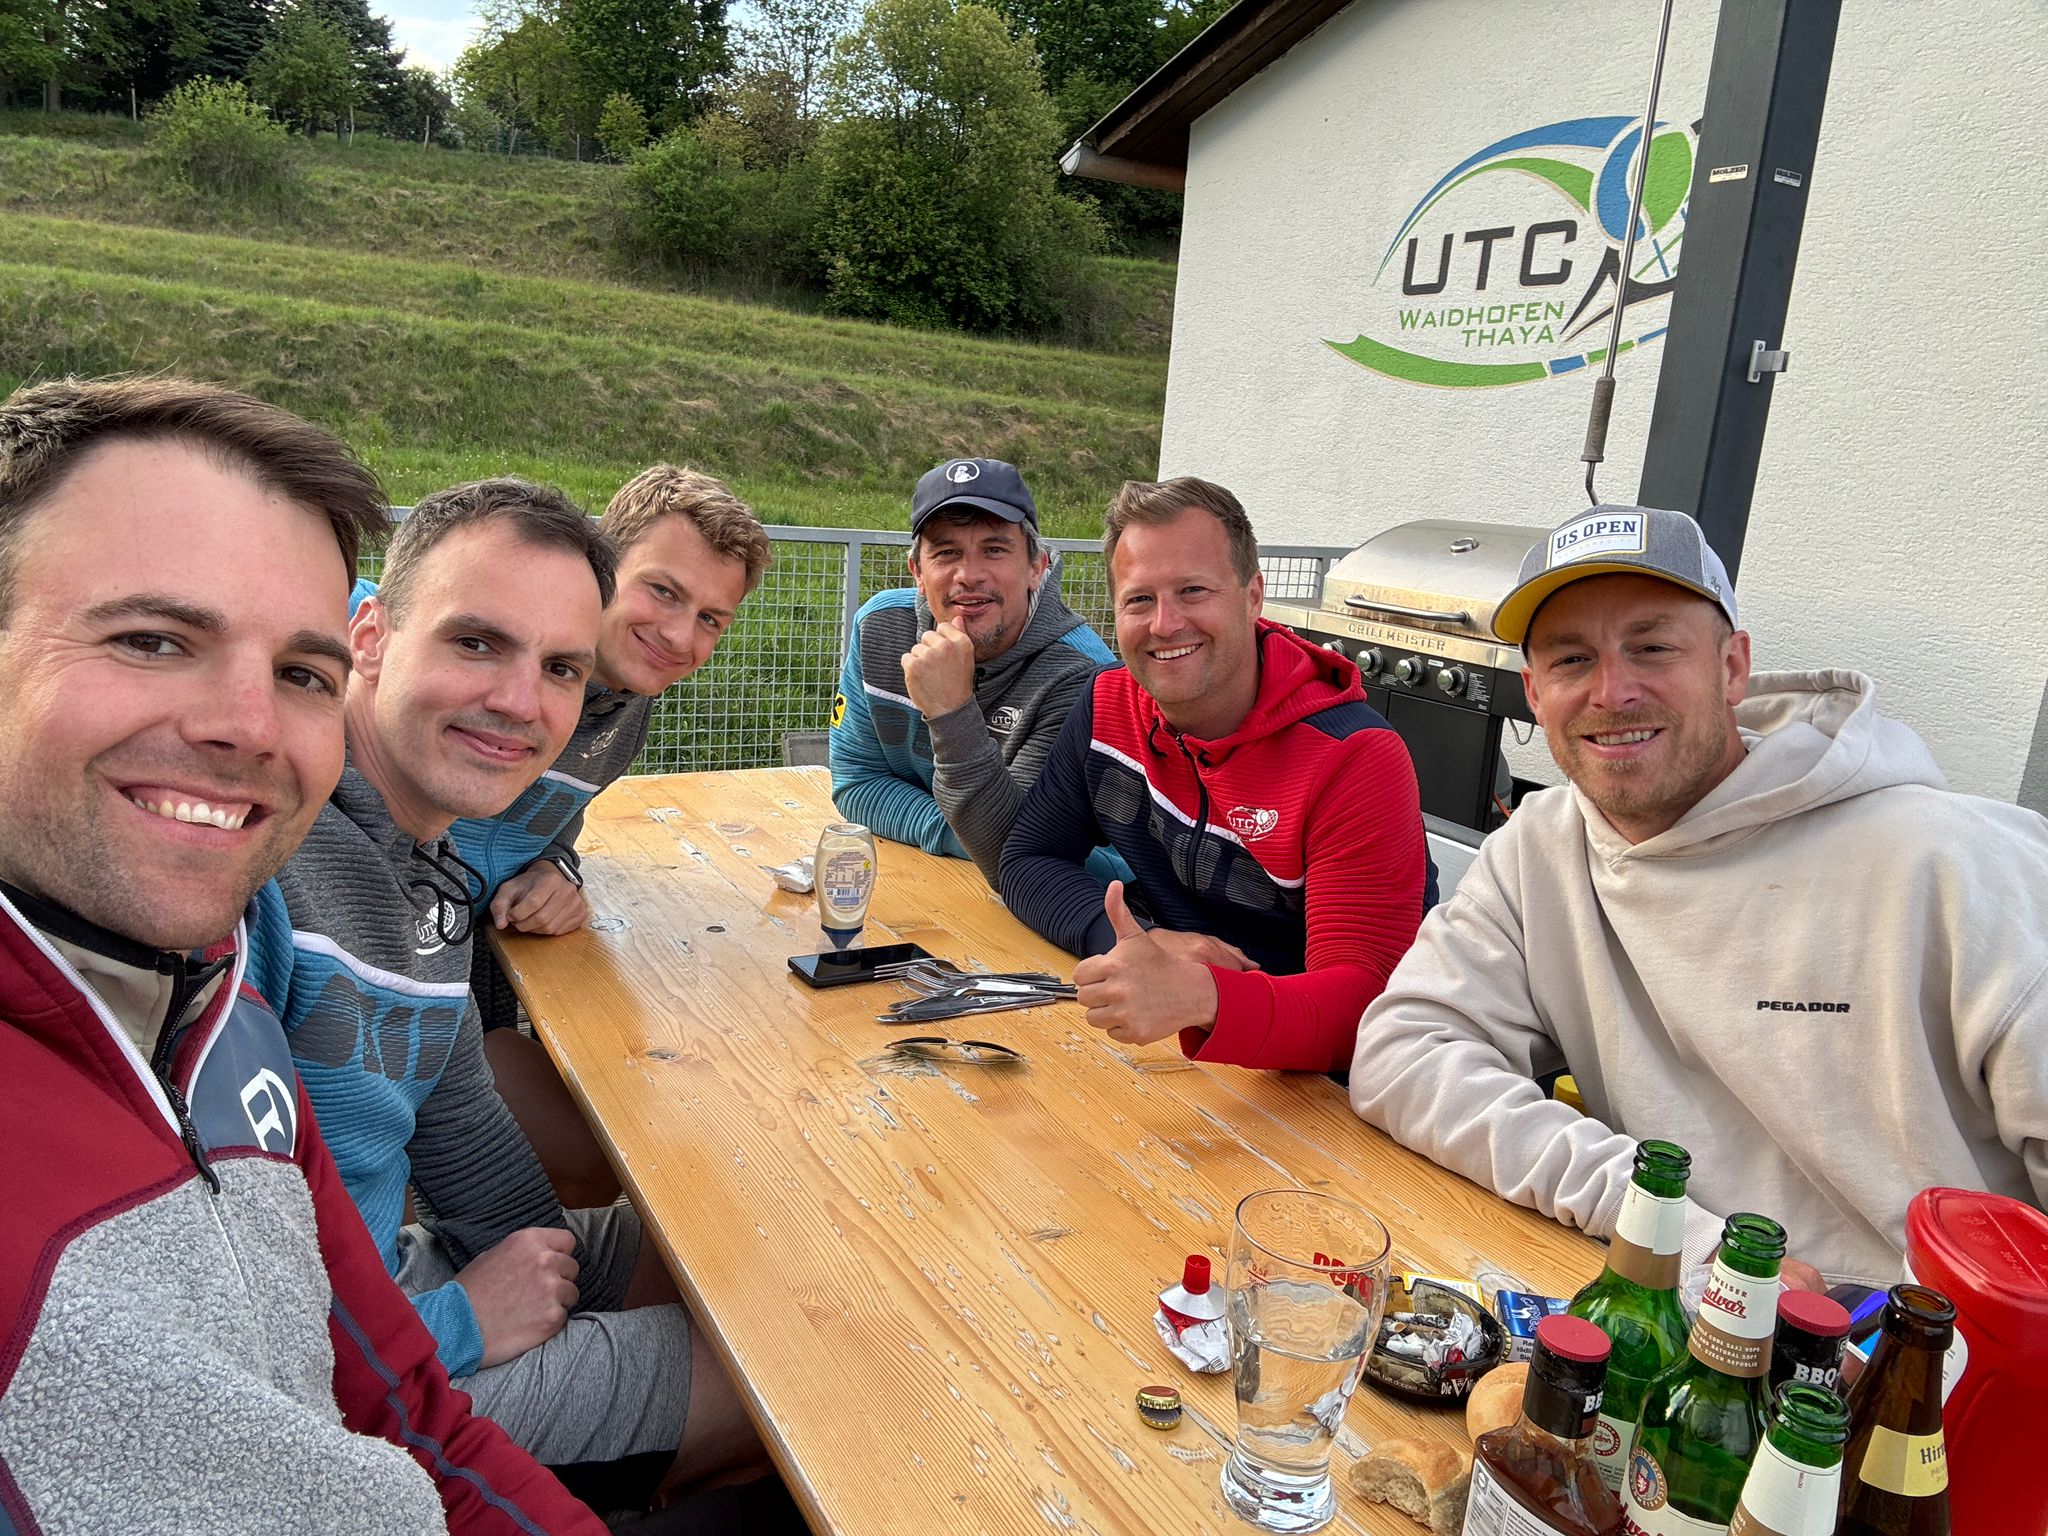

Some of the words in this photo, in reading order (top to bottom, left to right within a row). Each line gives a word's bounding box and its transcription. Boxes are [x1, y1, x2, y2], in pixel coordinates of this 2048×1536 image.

[1403, 219, 1577, 295] UTC
[1400, 301, 1564, 330] WAIDHOFEN
[1461, 324, 1554, 347] THAYA
[1557, 530, 1578, 549] US
[1583, 521, 1637, 537] OPEN
[1348, 624, 1446, 650] GRILLMEISTER
[992, 715, 1011, 724] UTC
[1229, 817, 1255, 829] UTC
[1757, 1001, 1850, 1013] PEGADOR
[1703, 1287, 1747, 1319] udvar
[1793, 1362, 1837, 1388] BBQ
